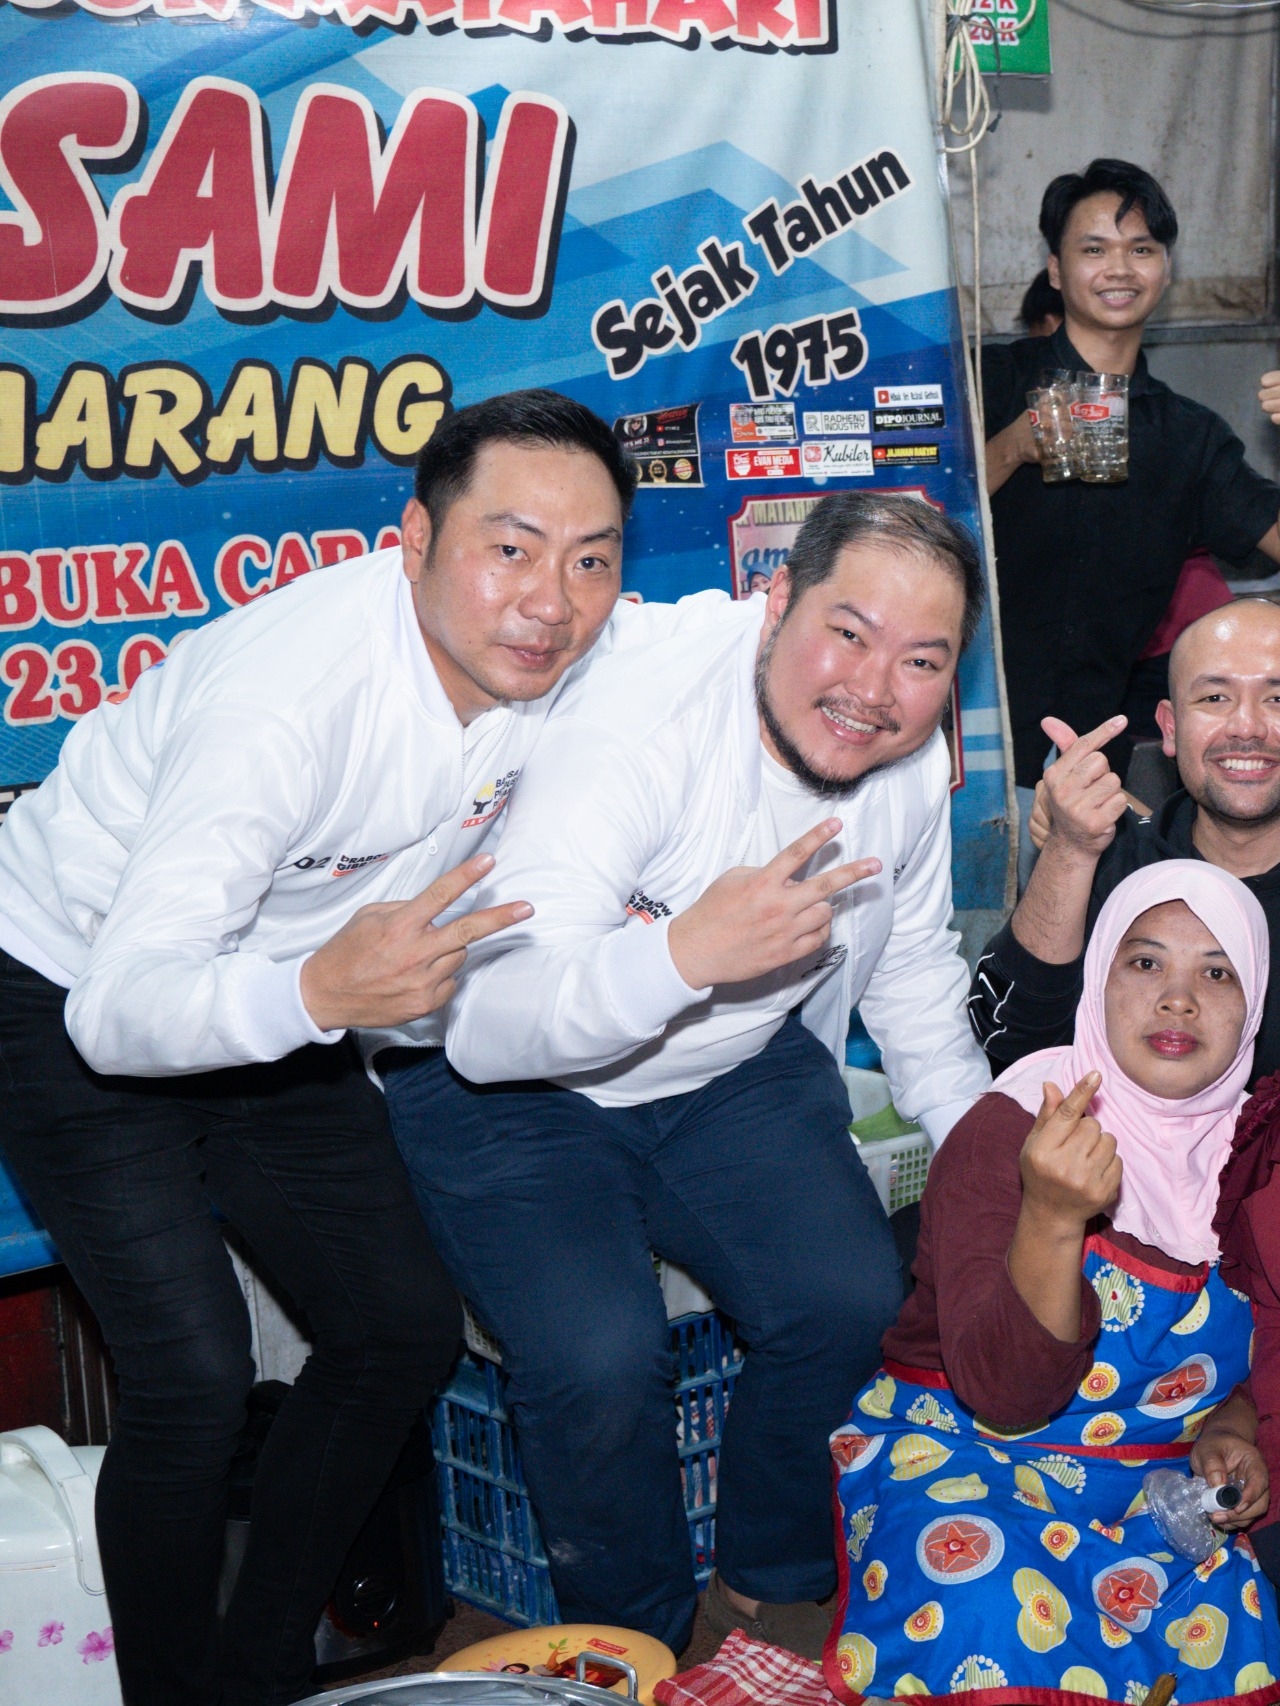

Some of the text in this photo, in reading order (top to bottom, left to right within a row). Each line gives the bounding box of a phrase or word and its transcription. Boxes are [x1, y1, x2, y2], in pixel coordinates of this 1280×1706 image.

[0, 78, 572, 308] SAMI
[593, 149, 913, 379] Sejak Tahun
[734, 310, 867, 399] 1975
[0, 543, 207, 628] BUKA
